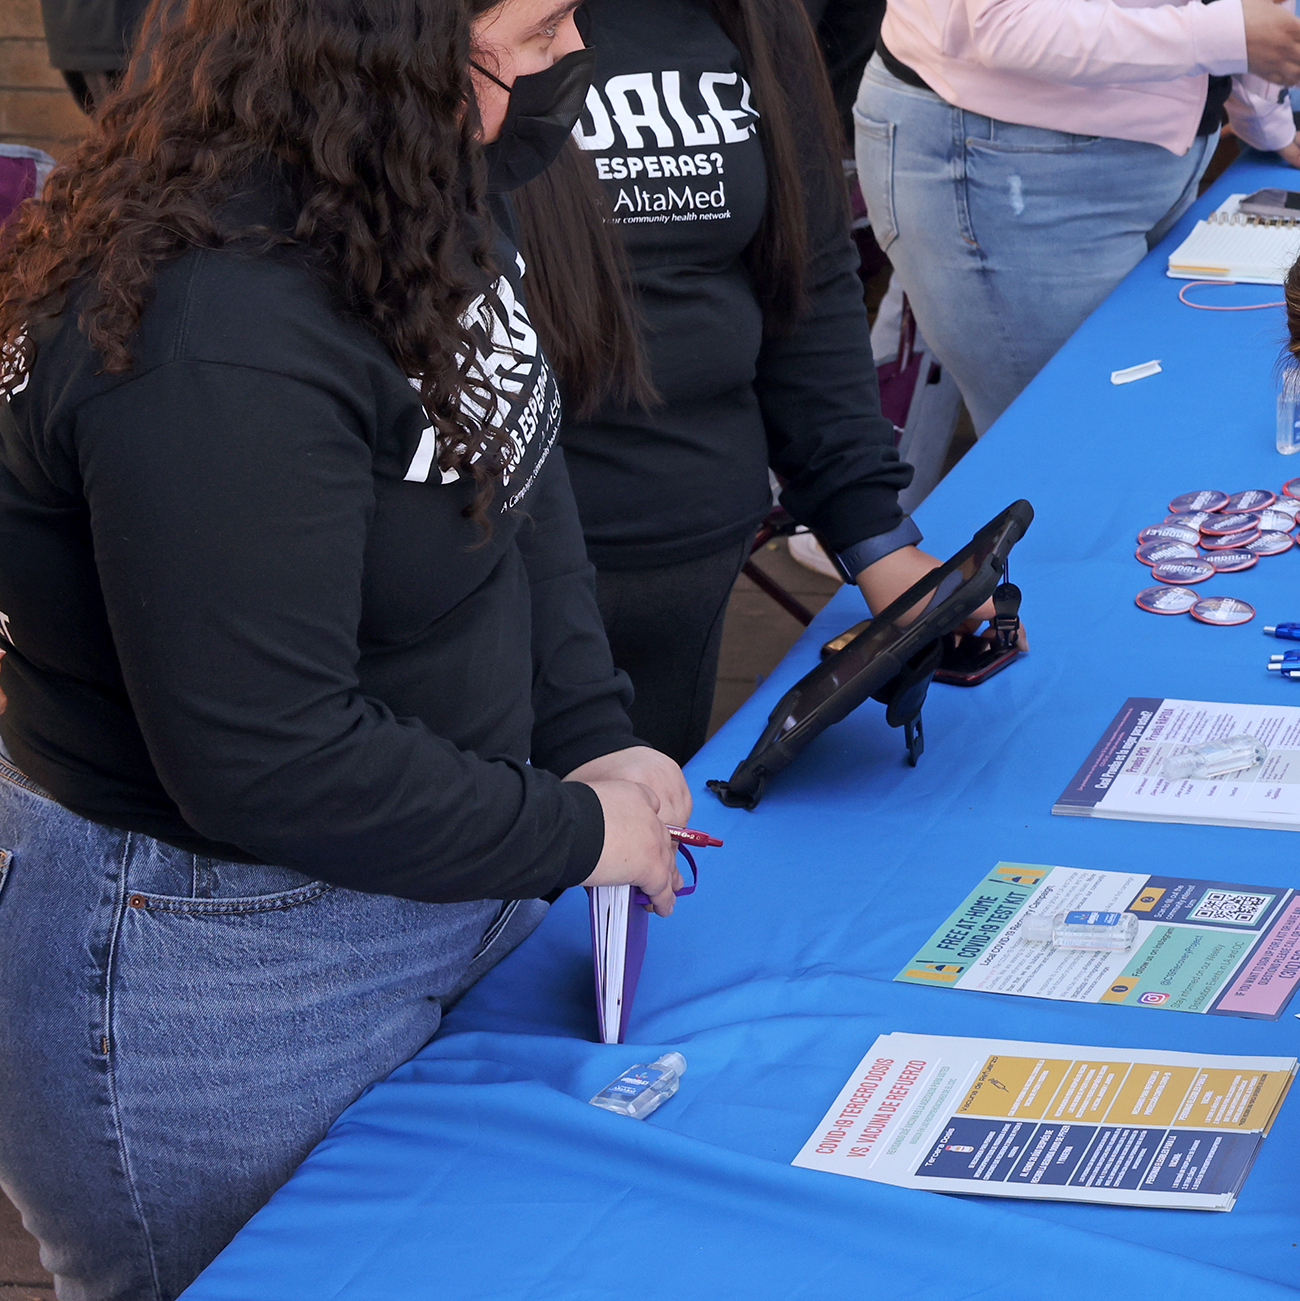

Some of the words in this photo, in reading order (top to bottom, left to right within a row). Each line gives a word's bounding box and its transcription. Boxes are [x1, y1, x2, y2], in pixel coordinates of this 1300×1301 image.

[594, 151, 725, 180] ESPERAS?
[612, 180, 726, 213] AltaMed
[622, 213, 670, 225] community
[671, 212, 698, 223] health
[699, 209, 732, 222] network
[1145, 725, 1164, 740] Prueba
[1102, 761, 1122, 777] Prueba
[1122, 736, 1137, 749] mejor
[1131, 726, 1144, 736] para
[1126, 757, 1145, 772] Prueba
[1136, 747, 1150, 756] PCR
[937, 929, 969, 950] FREE
[956, 896, 997, 929] AT-HOME
[958, 924, 999, 957] COVID-19
[986, 905, 1016, 923] TEST
[1003, 891, 1026, 904] KIT
[1154, 908, 1166, 917] Scan
[1166, 900, 1186, 919] community
[980, 953, 996, 965] Local
[991, 931, 1015, 953] COVID-19
[1132, 962, 1149, 976] Follow
[1153, 928, 1174, 948] Instagram
[1258, 963, 1282, 986] QUESTIONS
[1273, 947, 1291, 963] PLEASE
[1284, 937, 1298, 947] CALL
[1170, 997, 1186, 1008] Stay
[1178, 977, 1200, 997] informed
[1205, 944, 1225, 961] Weekly
[886, 1060, 926, 1100] REFUERZO
[960, 1090, 978, 1111] Vacuna
[979, 1056, 998, 1081] Refuerzo
[816, 1120, 853, 1153] COVID-19
[840, 1082, 878, 1117] TERCERO
[864, 1058, 894, 1081] DOSIS
[878, 1101, 900, 1112] DE
[857, 1114, 892, 1142] VACUNA
[847, 1145, 871, 1157] VS.
[925, 1144, 944, 1166] Tercera
[940, 1128, 955, 1143] Dosis
